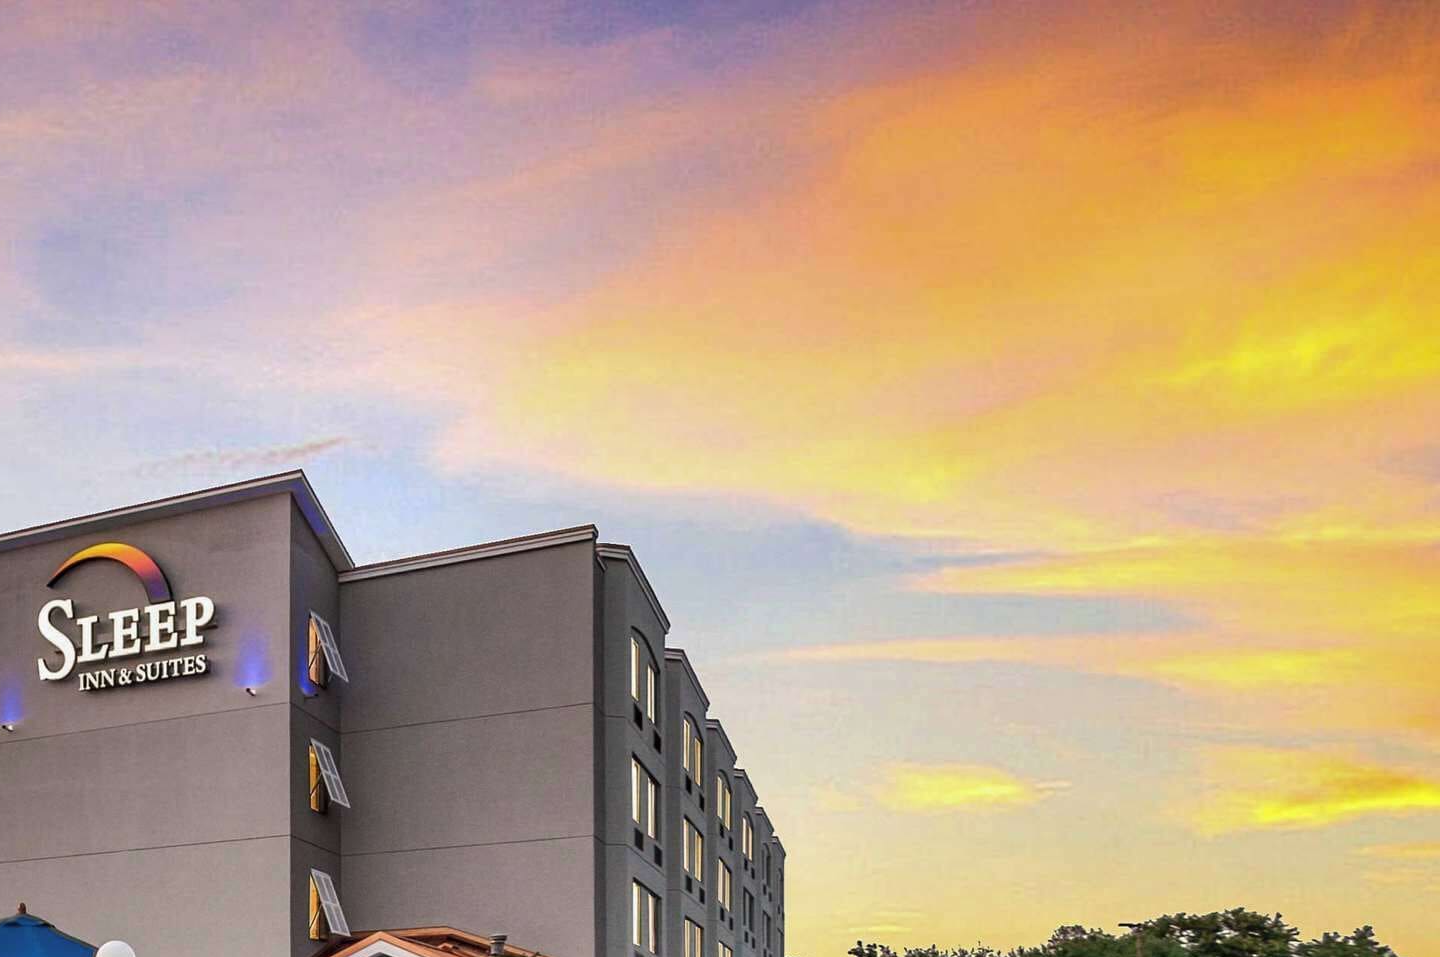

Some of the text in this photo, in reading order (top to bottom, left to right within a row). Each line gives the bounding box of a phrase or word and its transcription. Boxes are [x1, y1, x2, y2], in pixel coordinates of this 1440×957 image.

[37, 595, 215, 681] SLEEP
[78, 654, 207, 691] INN & SUITES
